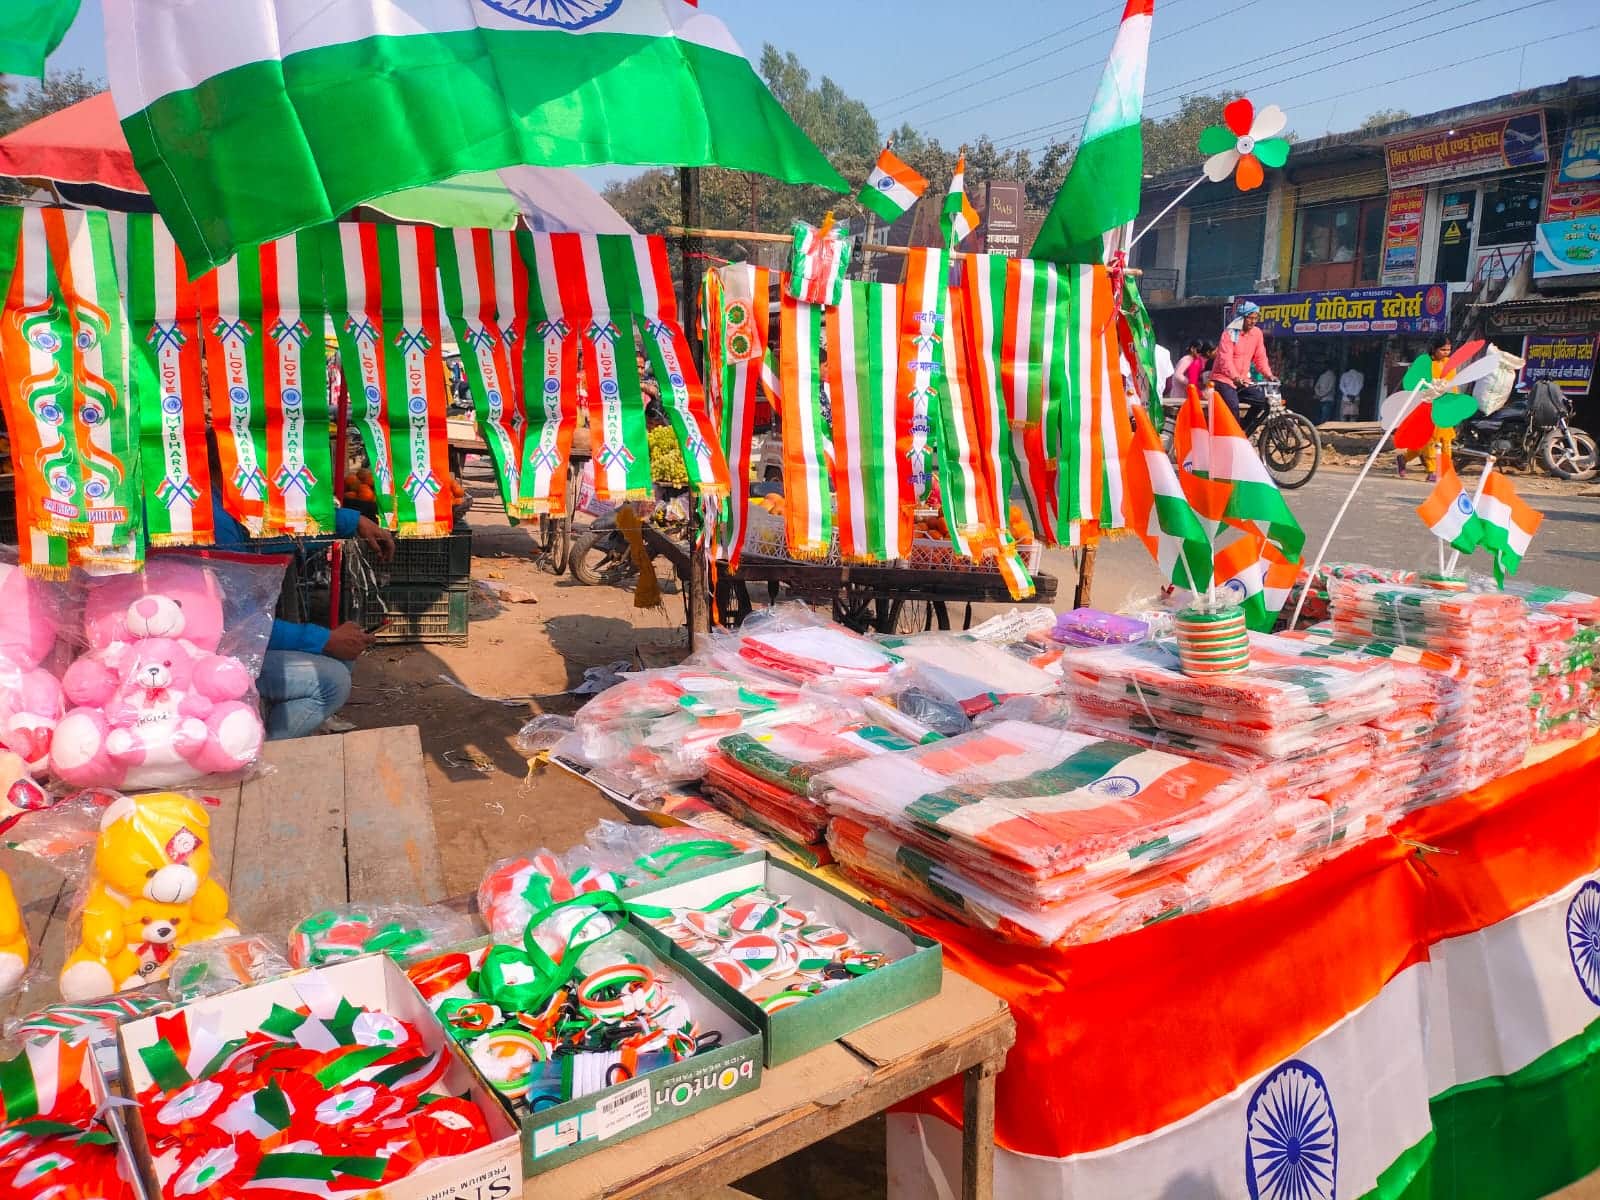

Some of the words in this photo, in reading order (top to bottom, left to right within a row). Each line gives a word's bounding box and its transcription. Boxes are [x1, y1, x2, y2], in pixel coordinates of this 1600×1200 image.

[1315, 297, 1377, 322] प्रोविजन
[1381, 292, 1424, 318] स्टोर्स
[166, 349, 171, 358] I
[231, 341, 237, 349] I
[363, 341, 369, 350] I
[412, 353, 417, 361] I
[230, 352, 244, 384] LOVE
[284, 356, 297, 386] LOVE
[362, 353, 375, 383] LOVE
[481, 361, 495, 388] LOVE
[547, 348, 559, 376] LOVE
[600, 352, 613, 378] LOVE
[661, 350, 677, 372] LOVE
[163, 363, 177, 393] LOVE
[409, 364, 422, 395] LOVE
[460, 1166, 507, 1190] PREMIUM
